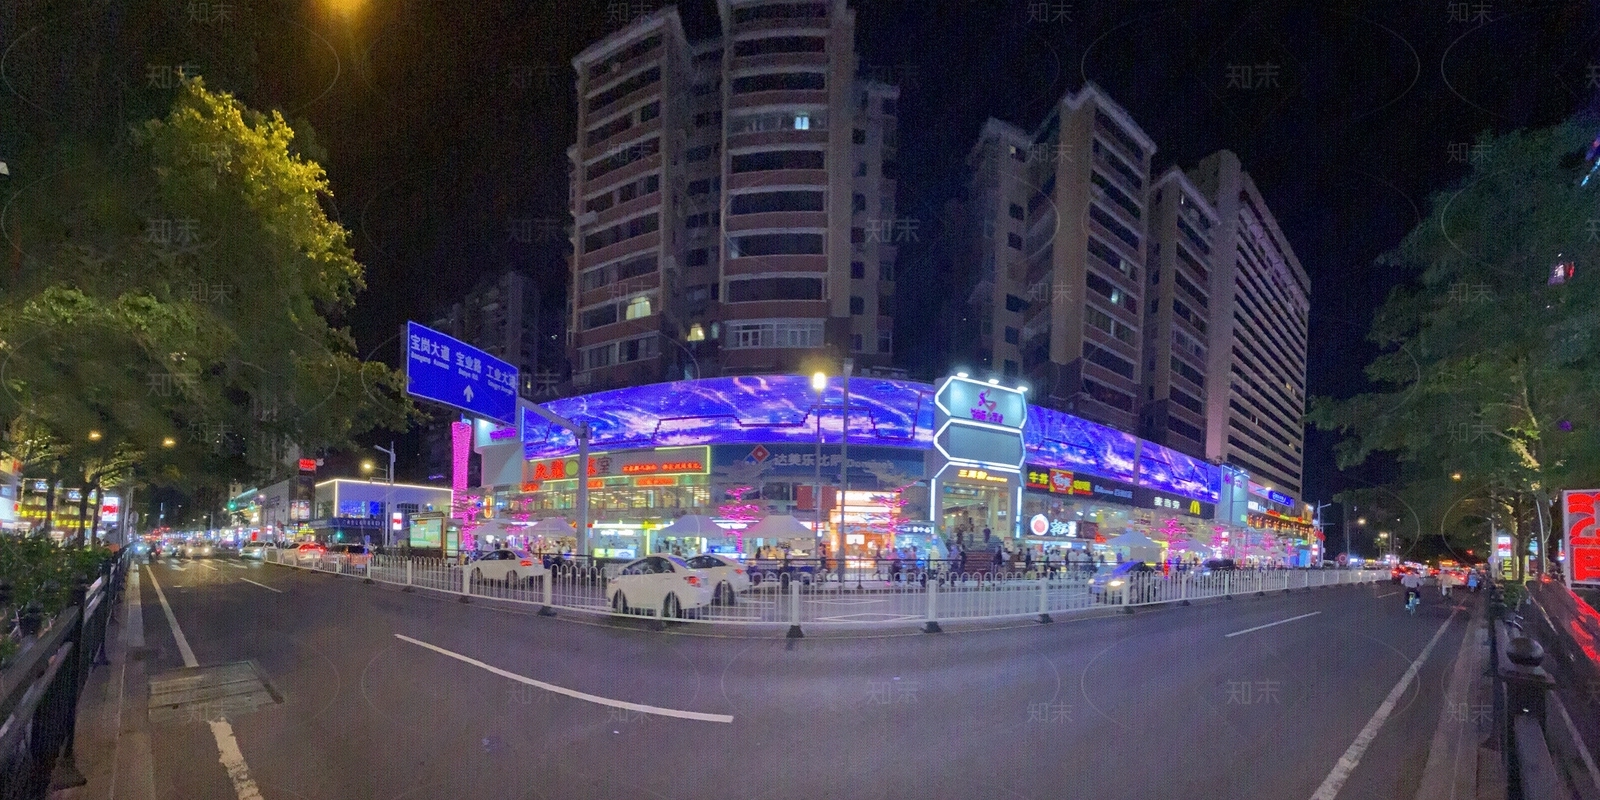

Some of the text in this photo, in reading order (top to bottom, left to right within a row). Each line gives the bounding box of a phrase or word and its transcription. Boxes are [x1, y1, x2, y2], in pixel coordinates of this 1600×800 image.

[411, 334, 450, 361] 宝岗大道
[486, 365, 516, 389] 工业大道
[1154, 496, 1180, 510] 麦当劳
